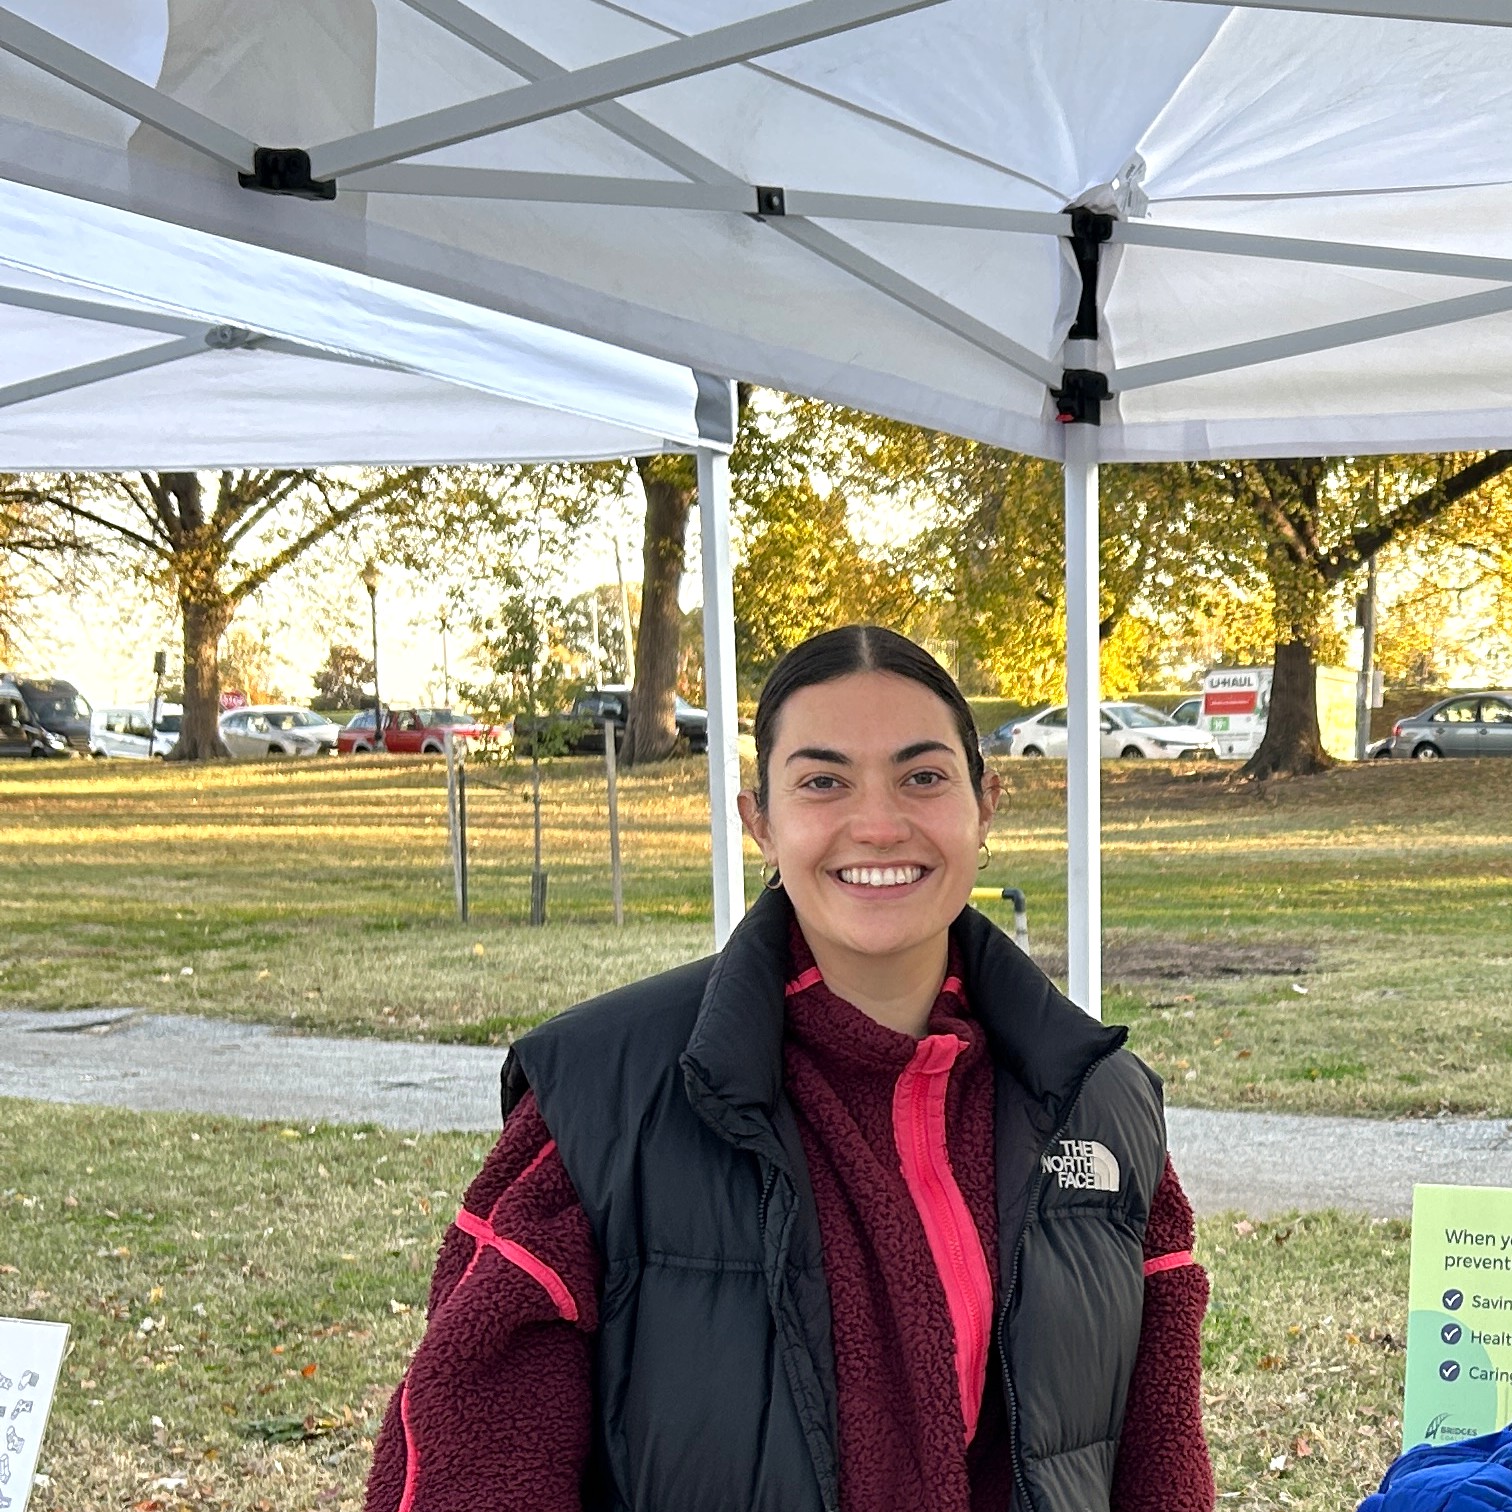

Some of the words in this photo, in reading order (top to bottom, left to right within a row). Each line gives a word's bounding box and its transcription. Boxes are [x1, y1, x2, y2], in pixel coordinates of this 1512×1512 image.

[1059, 1140, 1094, 1157] THE
[1041, 1155, 1094, 1174] NORTH
[1058, 1172, 1095, 1190] FACE
[1445, 1229, 1496, 1247] When
[1440, 1426, 1478, 1437] BRIDGES
